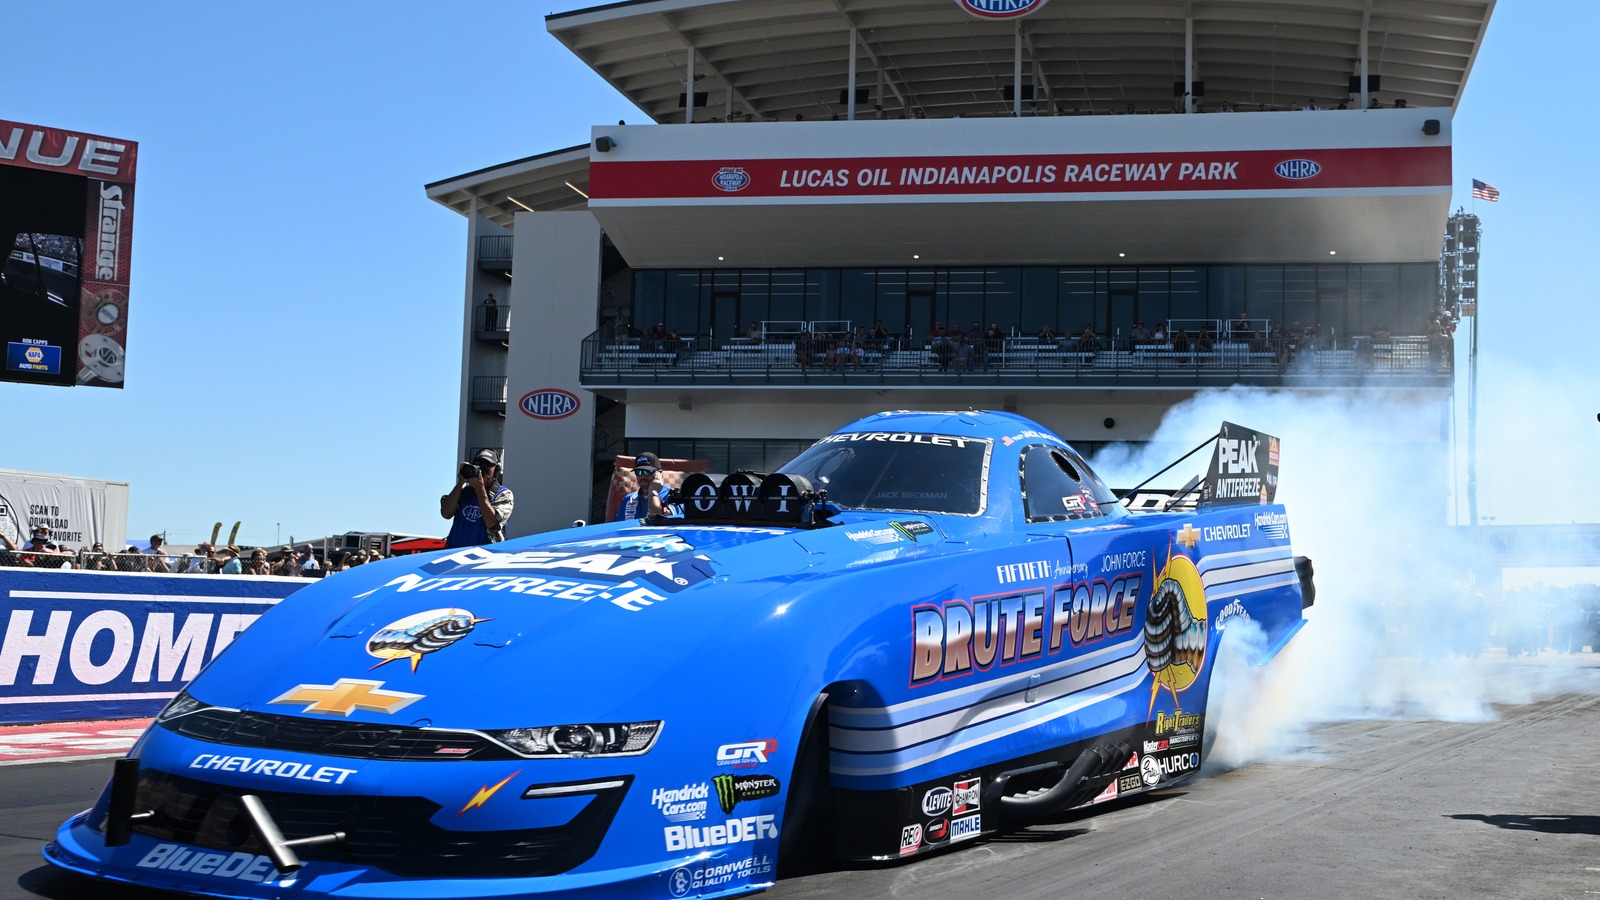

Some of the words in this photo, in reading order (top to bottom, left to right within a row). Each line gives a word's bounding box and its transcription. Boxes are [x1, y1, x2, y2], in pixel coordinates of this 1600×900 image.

[780, 169, 850, 188] LUCAS
[857, 168, 891, 186] OIL
[900, 165, 1056, 185] INDIANAPOLIS
[1064, 163, 1172, 183] RACEWAY
[1178, 161, 1239, 181] PARK
[1279, 159, 1317, 177] NHRA
[96, 181, 125, 281] Strange
[28, 351, 41, 359] NAPA
[528, 394, 571, 414] NHRA
[1219, 438, 1260, 474] PEAK
[875, 491, 899, 499] JACK
[1216, 478, 1261, 498] ANTIFREEZE
[30, 504, 49, 515] SCAN
[51, 506, 59, 516] TO
[29, 517, 69, 529] DOWNLOAD
[1204, 523, 1251, 542] CHEVROLET
[49, 531, 82, 542] FAVORITE
[996, 560, 1053, 584] FIFTIETH
[1101, 553, 1122, 573] JOHN
[1122, 551, 1146, 569] FORCE
[911, 590, 1045, 684] BRUTE
[1049, 575, 1140, 652] FORCE
[189, 754, 358, 785] CHEVROLET
[1158, 752, 1200, 775] HURCO
[735, 779, 777, 791] MONSTER
[652, 783, 709, 809] Hendrick
[923, 789, 953, 813] CLEVITE
[956, 790, 979, 804] CHAMPION
[663, 801, 707, 816] Cars.com
[664, 814, 775, 852] BlueDEF
[952, 817, 980, 837] MAHLE
[692, 873, 733, 889] QUALITY
[737, 865, 771, 878] TOOLS
[693, 855, 770, 880] CORNWELL
